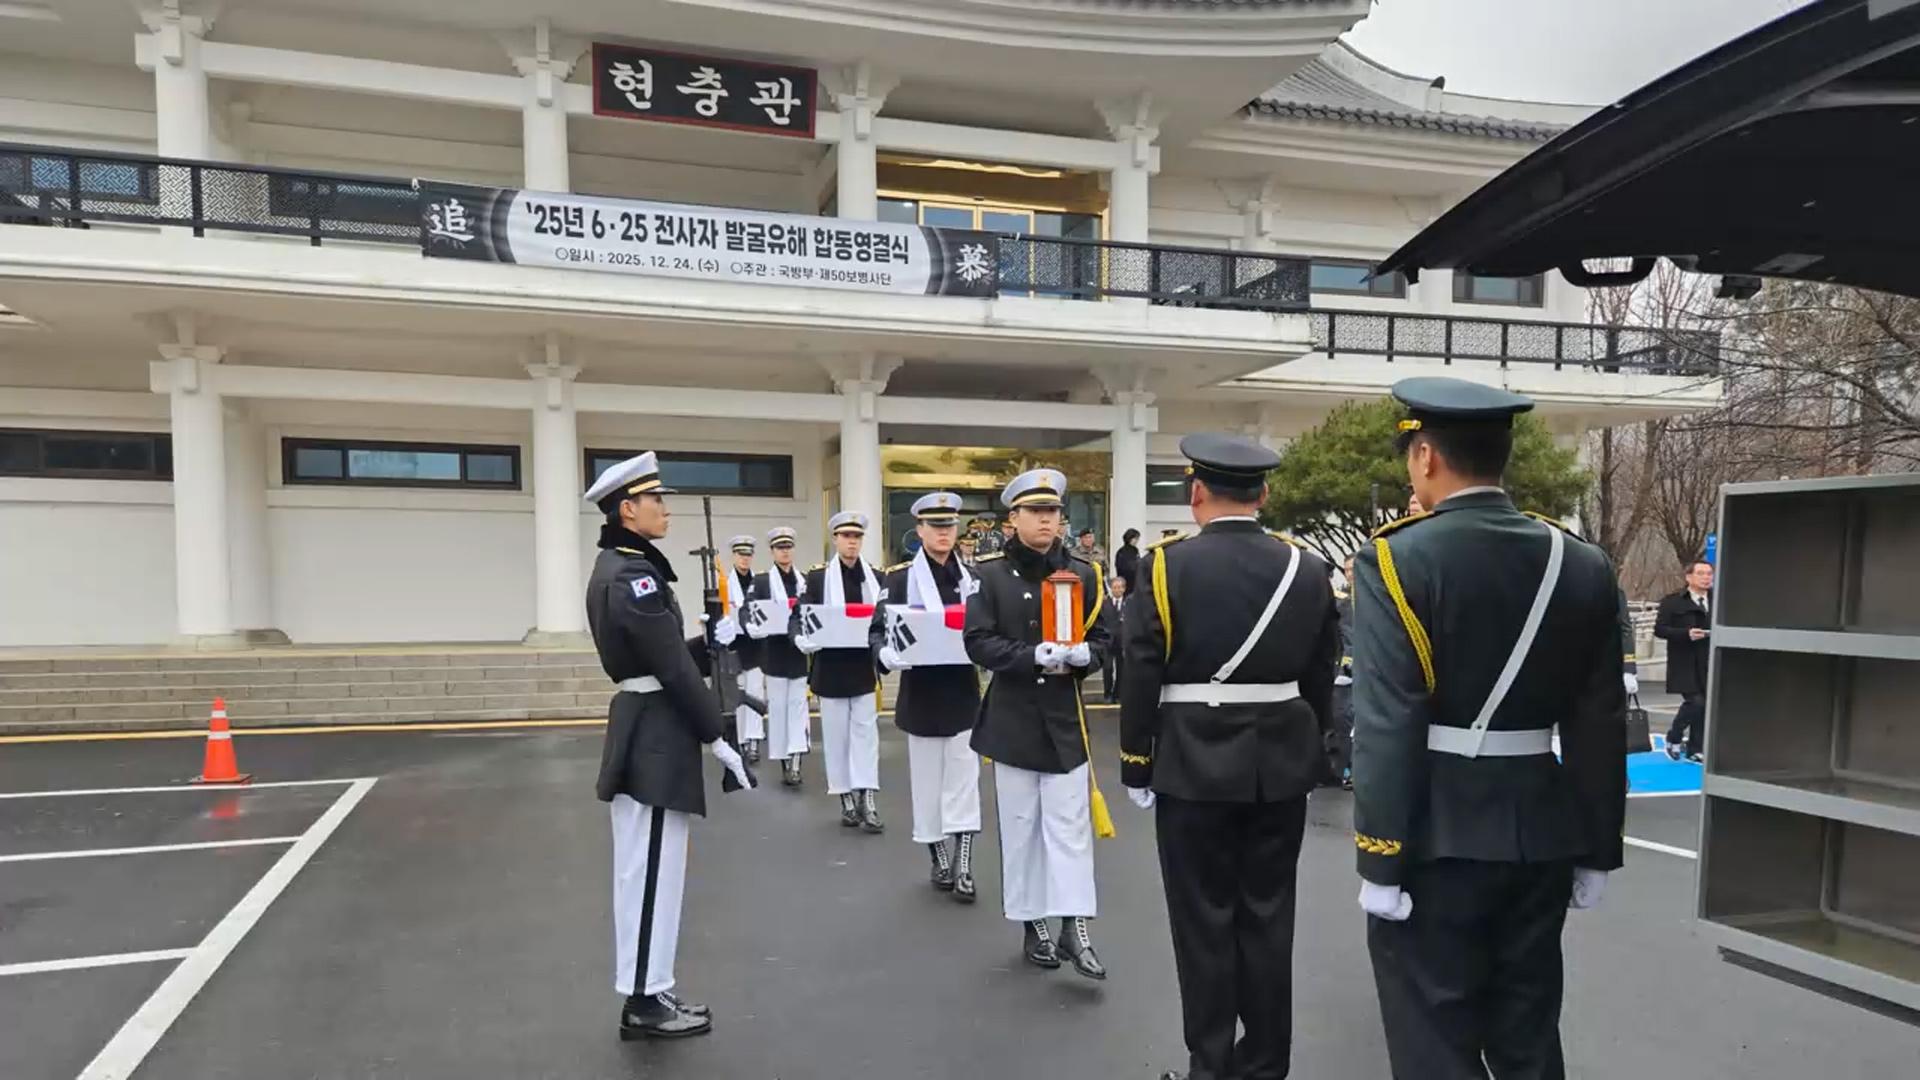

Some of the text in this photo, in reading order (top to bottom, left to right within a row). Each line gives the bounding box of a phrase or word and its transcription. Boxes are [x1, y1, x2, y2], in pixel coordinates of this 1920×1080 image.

[608, 59, 801, 125] 현충관
[430, 198, 475, 242] 追
[654, 214, 719, 249] 전사자
[725, 220, 808, 257] 발굴유해
[813, 227, 909, 265] 합동영결식
[608, 252, 645, 267] 2025.
[650, 256, 670, 269] 12.
[674, 258, 694, 271] 24.
[698, 259, 720, 273] (수)
[955, 243, 990, 281] 慕
